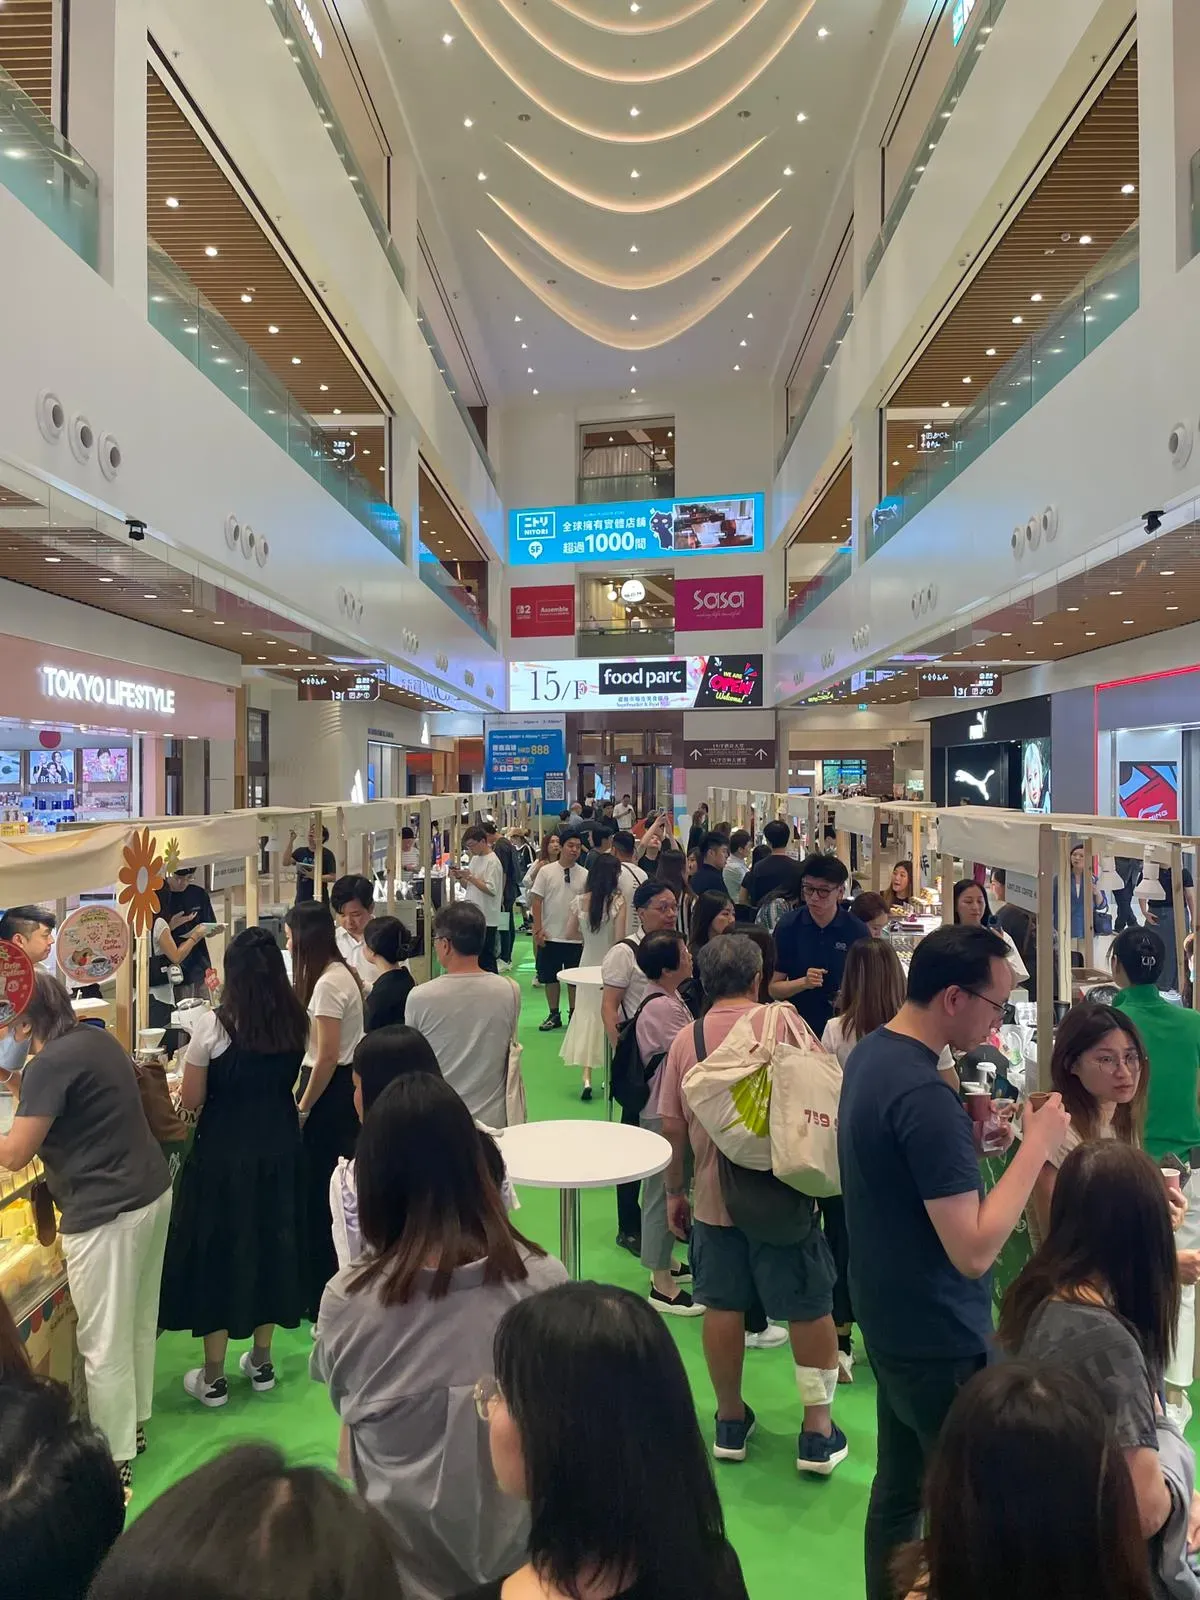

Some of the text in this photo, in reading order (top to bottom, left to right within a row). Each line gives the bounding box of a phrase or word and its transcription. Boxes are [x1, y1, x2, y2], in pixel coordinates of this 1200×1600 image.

[524, 516, 548, 528] ニトリ
[524, 528, 548, 536] NITORI
[530, 545, 541, 554] 5F
[604, 668, 682, 688] food parc
[43, 667, 175, 714] TOKYO LIFESTYLE
[529, 670, 588, 701] 15/F
[710, 675, 755, 695] OPEN
[531, 744, 550, 755] 888
[4, 962, 20, 970] Drip
